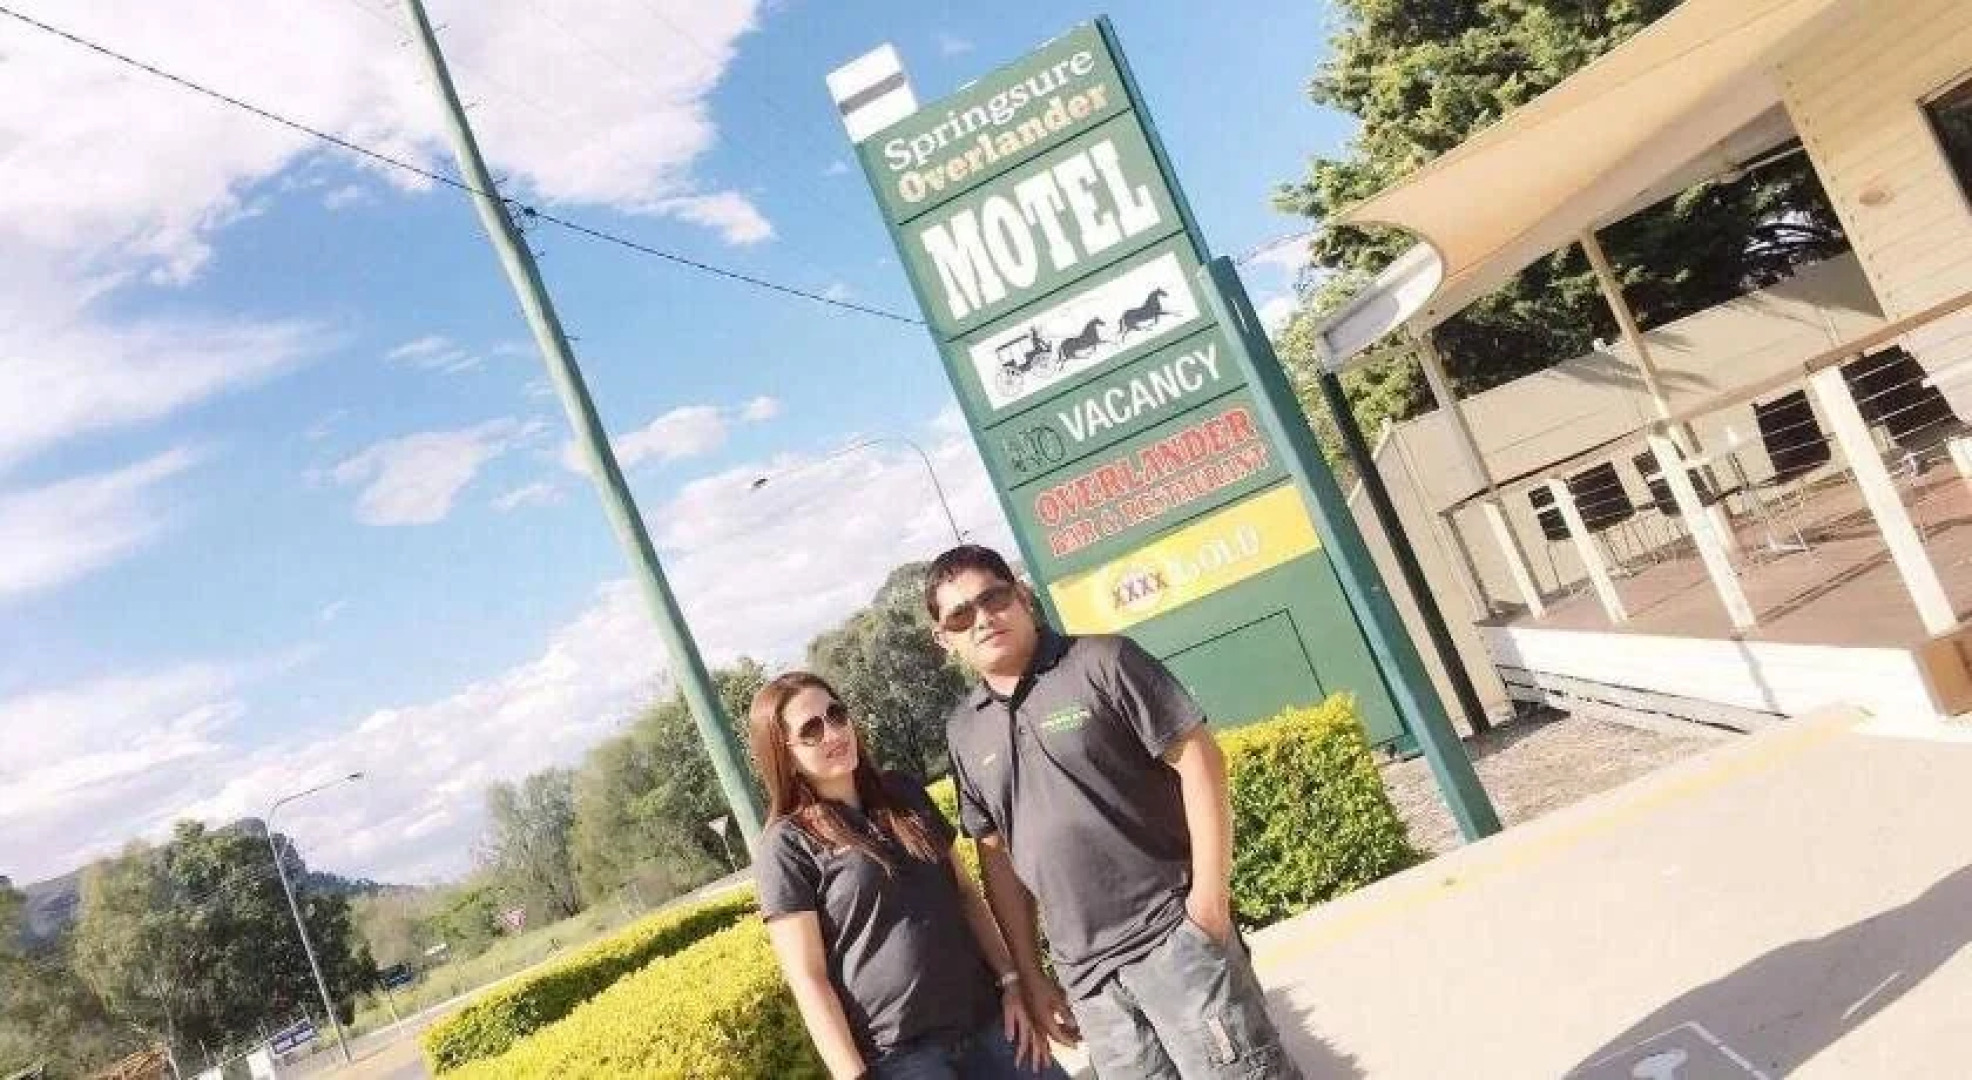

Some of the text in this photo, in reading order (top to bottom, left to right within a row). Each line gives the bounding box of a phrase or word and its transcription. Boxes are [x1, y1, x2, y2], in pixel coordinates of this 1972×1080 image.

[884, 49, 1094, 171] Springsure
[899, 83, 1107, 202] Overlander
[920, 139, 1161, 320] MOTEL
[1060, 343, 1222, 442] VACANCY
[1036, 408, 1257, 526] OVERLANDER
